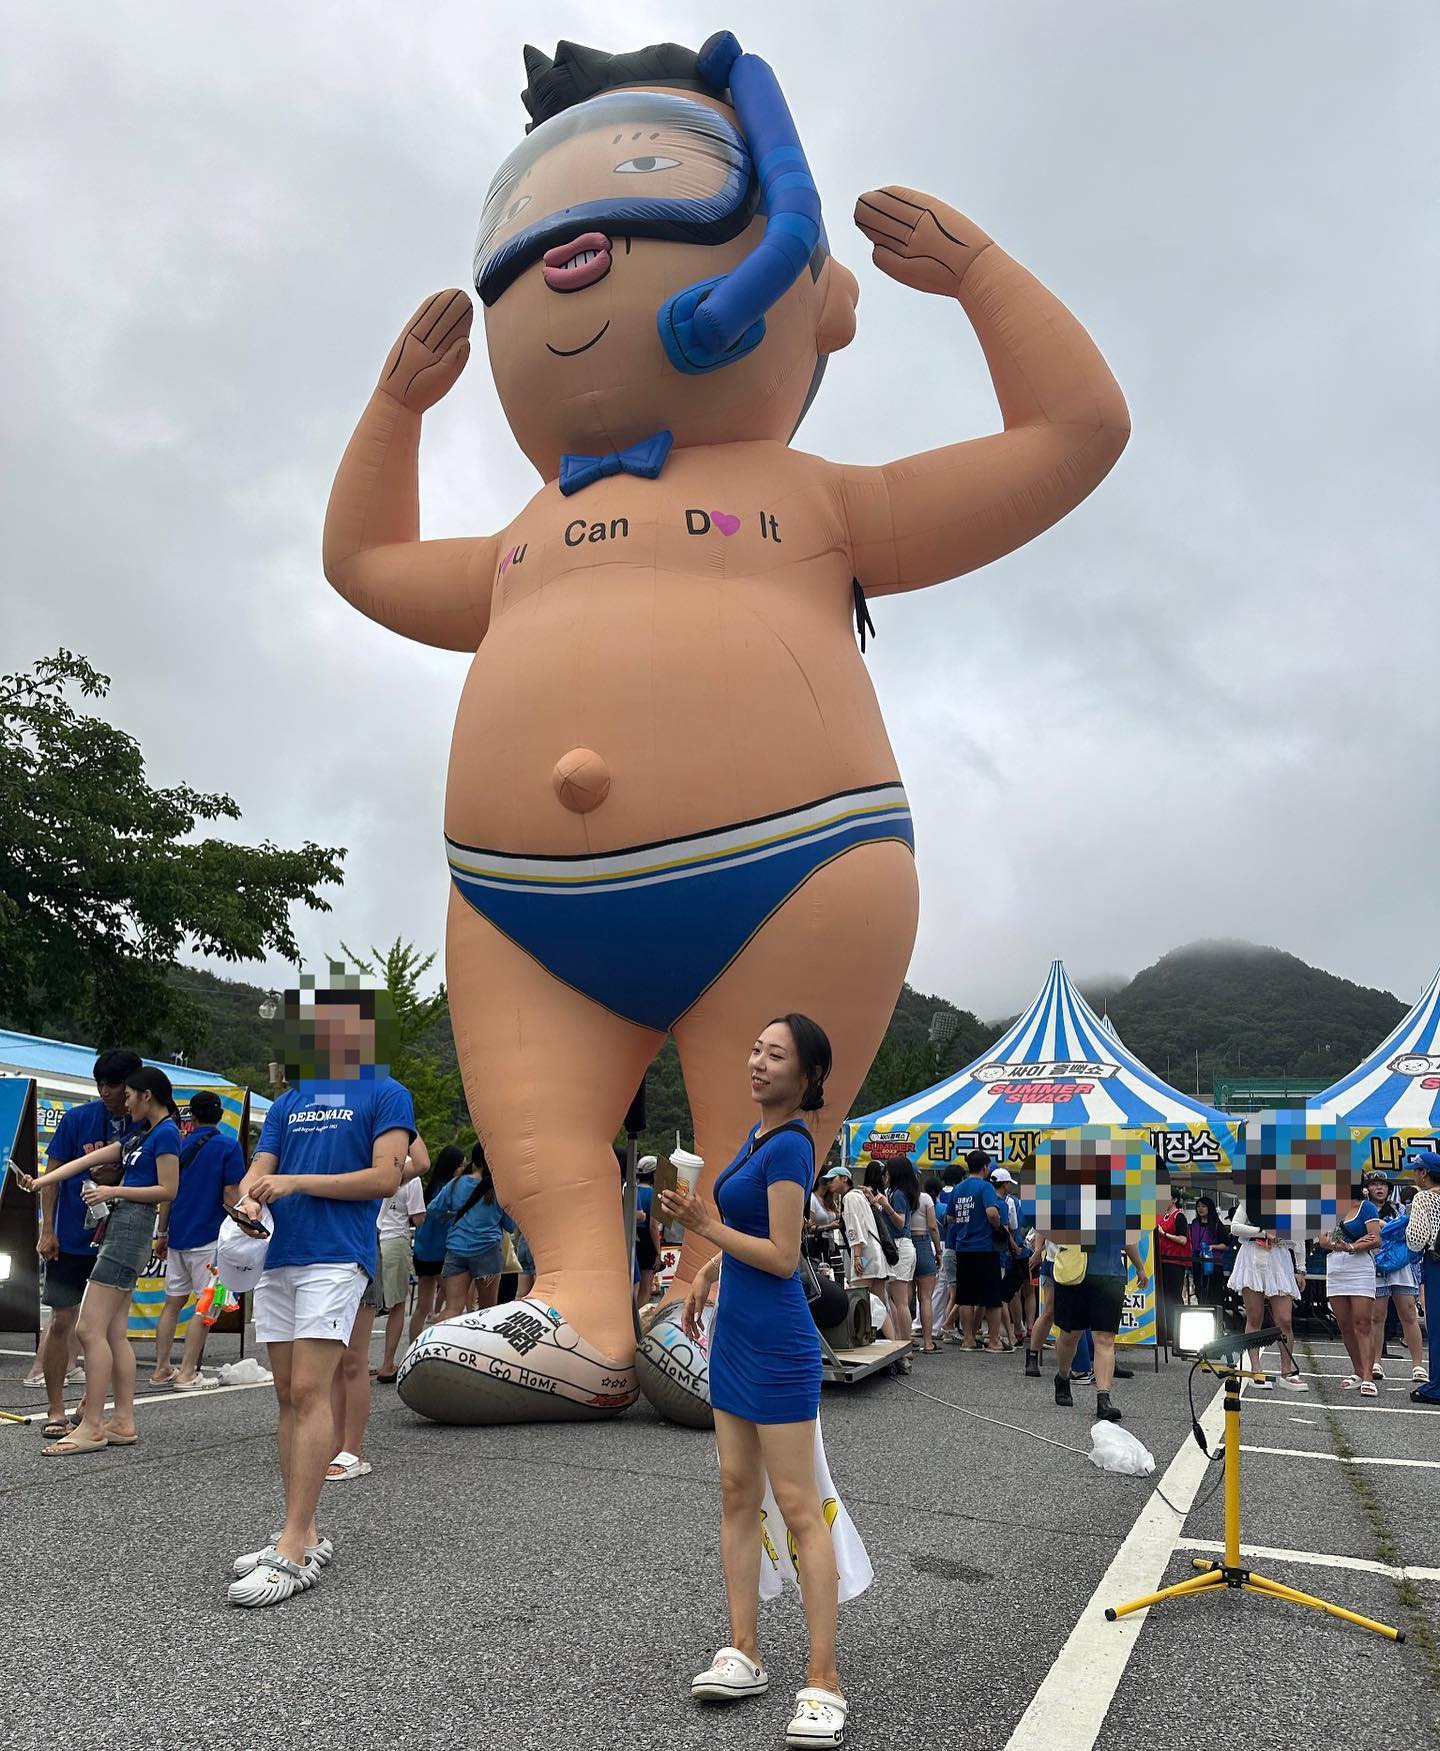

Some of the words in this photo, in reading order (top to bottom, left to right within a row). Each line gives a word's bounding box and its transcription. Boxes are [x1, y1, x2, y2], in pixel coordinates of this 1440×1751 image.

[564, 517, 629, 547] Can
[760, 511, 782, 543] It
[1008, 1065, 1046, 1077] 싸이
[988, 1083, 1095, 1095] SUMMER
[1005, 1094, 1074, 1104] SWAG
[288, 1108, 354, 1125] DEBONAIR
[863, 1142, 915, 1152] SUMMER
[928, 1130, 954, 1162] 라
[957, 1130, 1004, 1163] 구역
[1370, 1136, 1405, 1171] 나
[505, 1310, 552, 1341] HANG
[493, 1322, 538, 1357] OVER
[459, 1352, 478, 1367] OR
